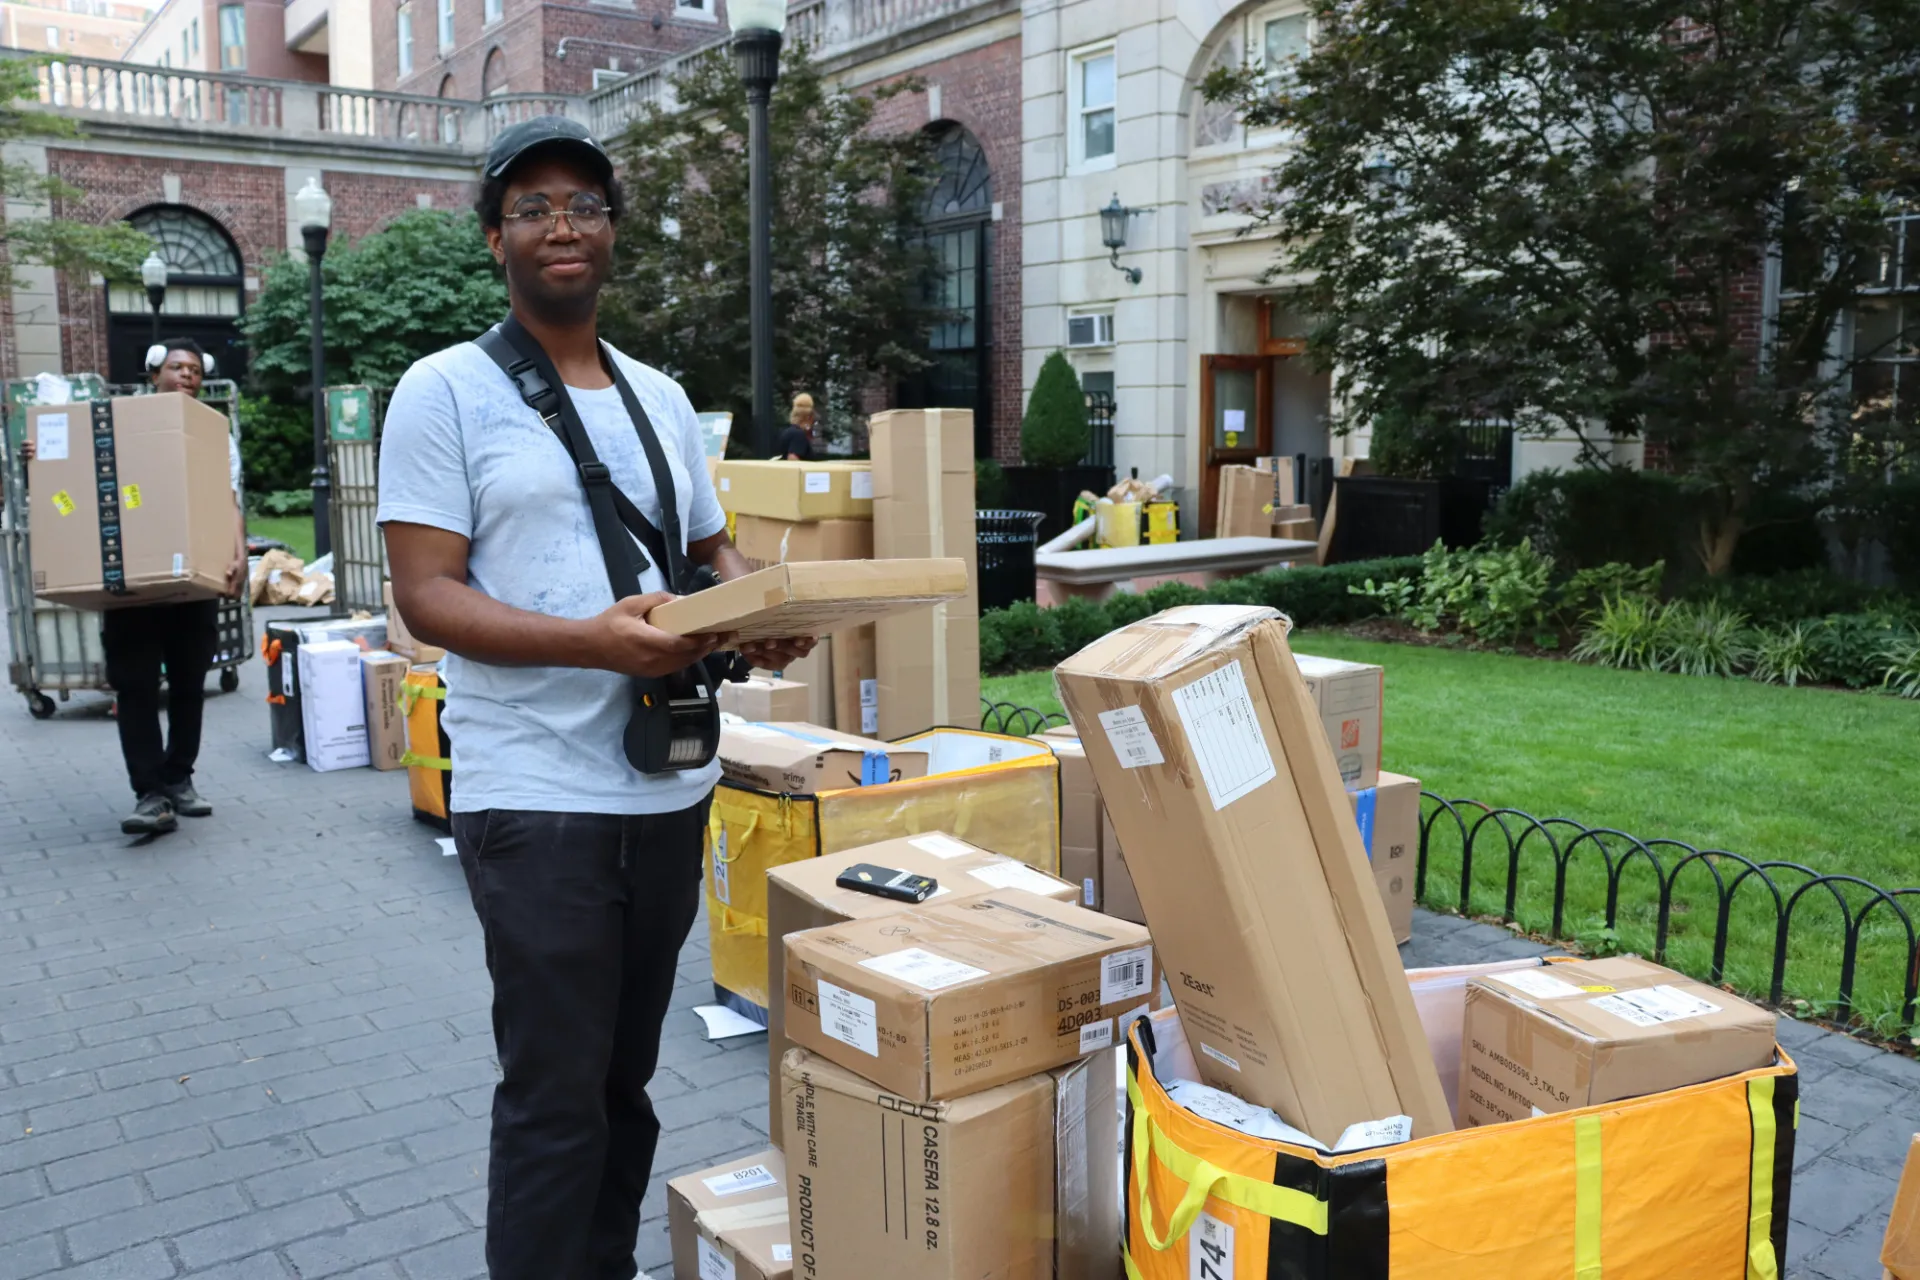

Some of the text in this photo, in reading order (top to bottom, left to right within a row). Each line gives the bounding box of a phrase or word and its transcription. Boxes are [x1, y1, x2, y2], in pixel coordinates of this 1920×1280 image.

[782, 770, 806, 785] prime
[796, 1094, 806, 1132] FRAGIL
[806, 1111, 816, 1139] WITH
[807, 1139, 818, 1169] CARE
[923, 1125, 940, 1191] CASERA
[733, 1166, 764, 1180] B201
[799, 1174, 815, 1252] PRODUCT
[925, 1196, 940, 1228] 12.8
[802, 1252, 816, 1276] OF
